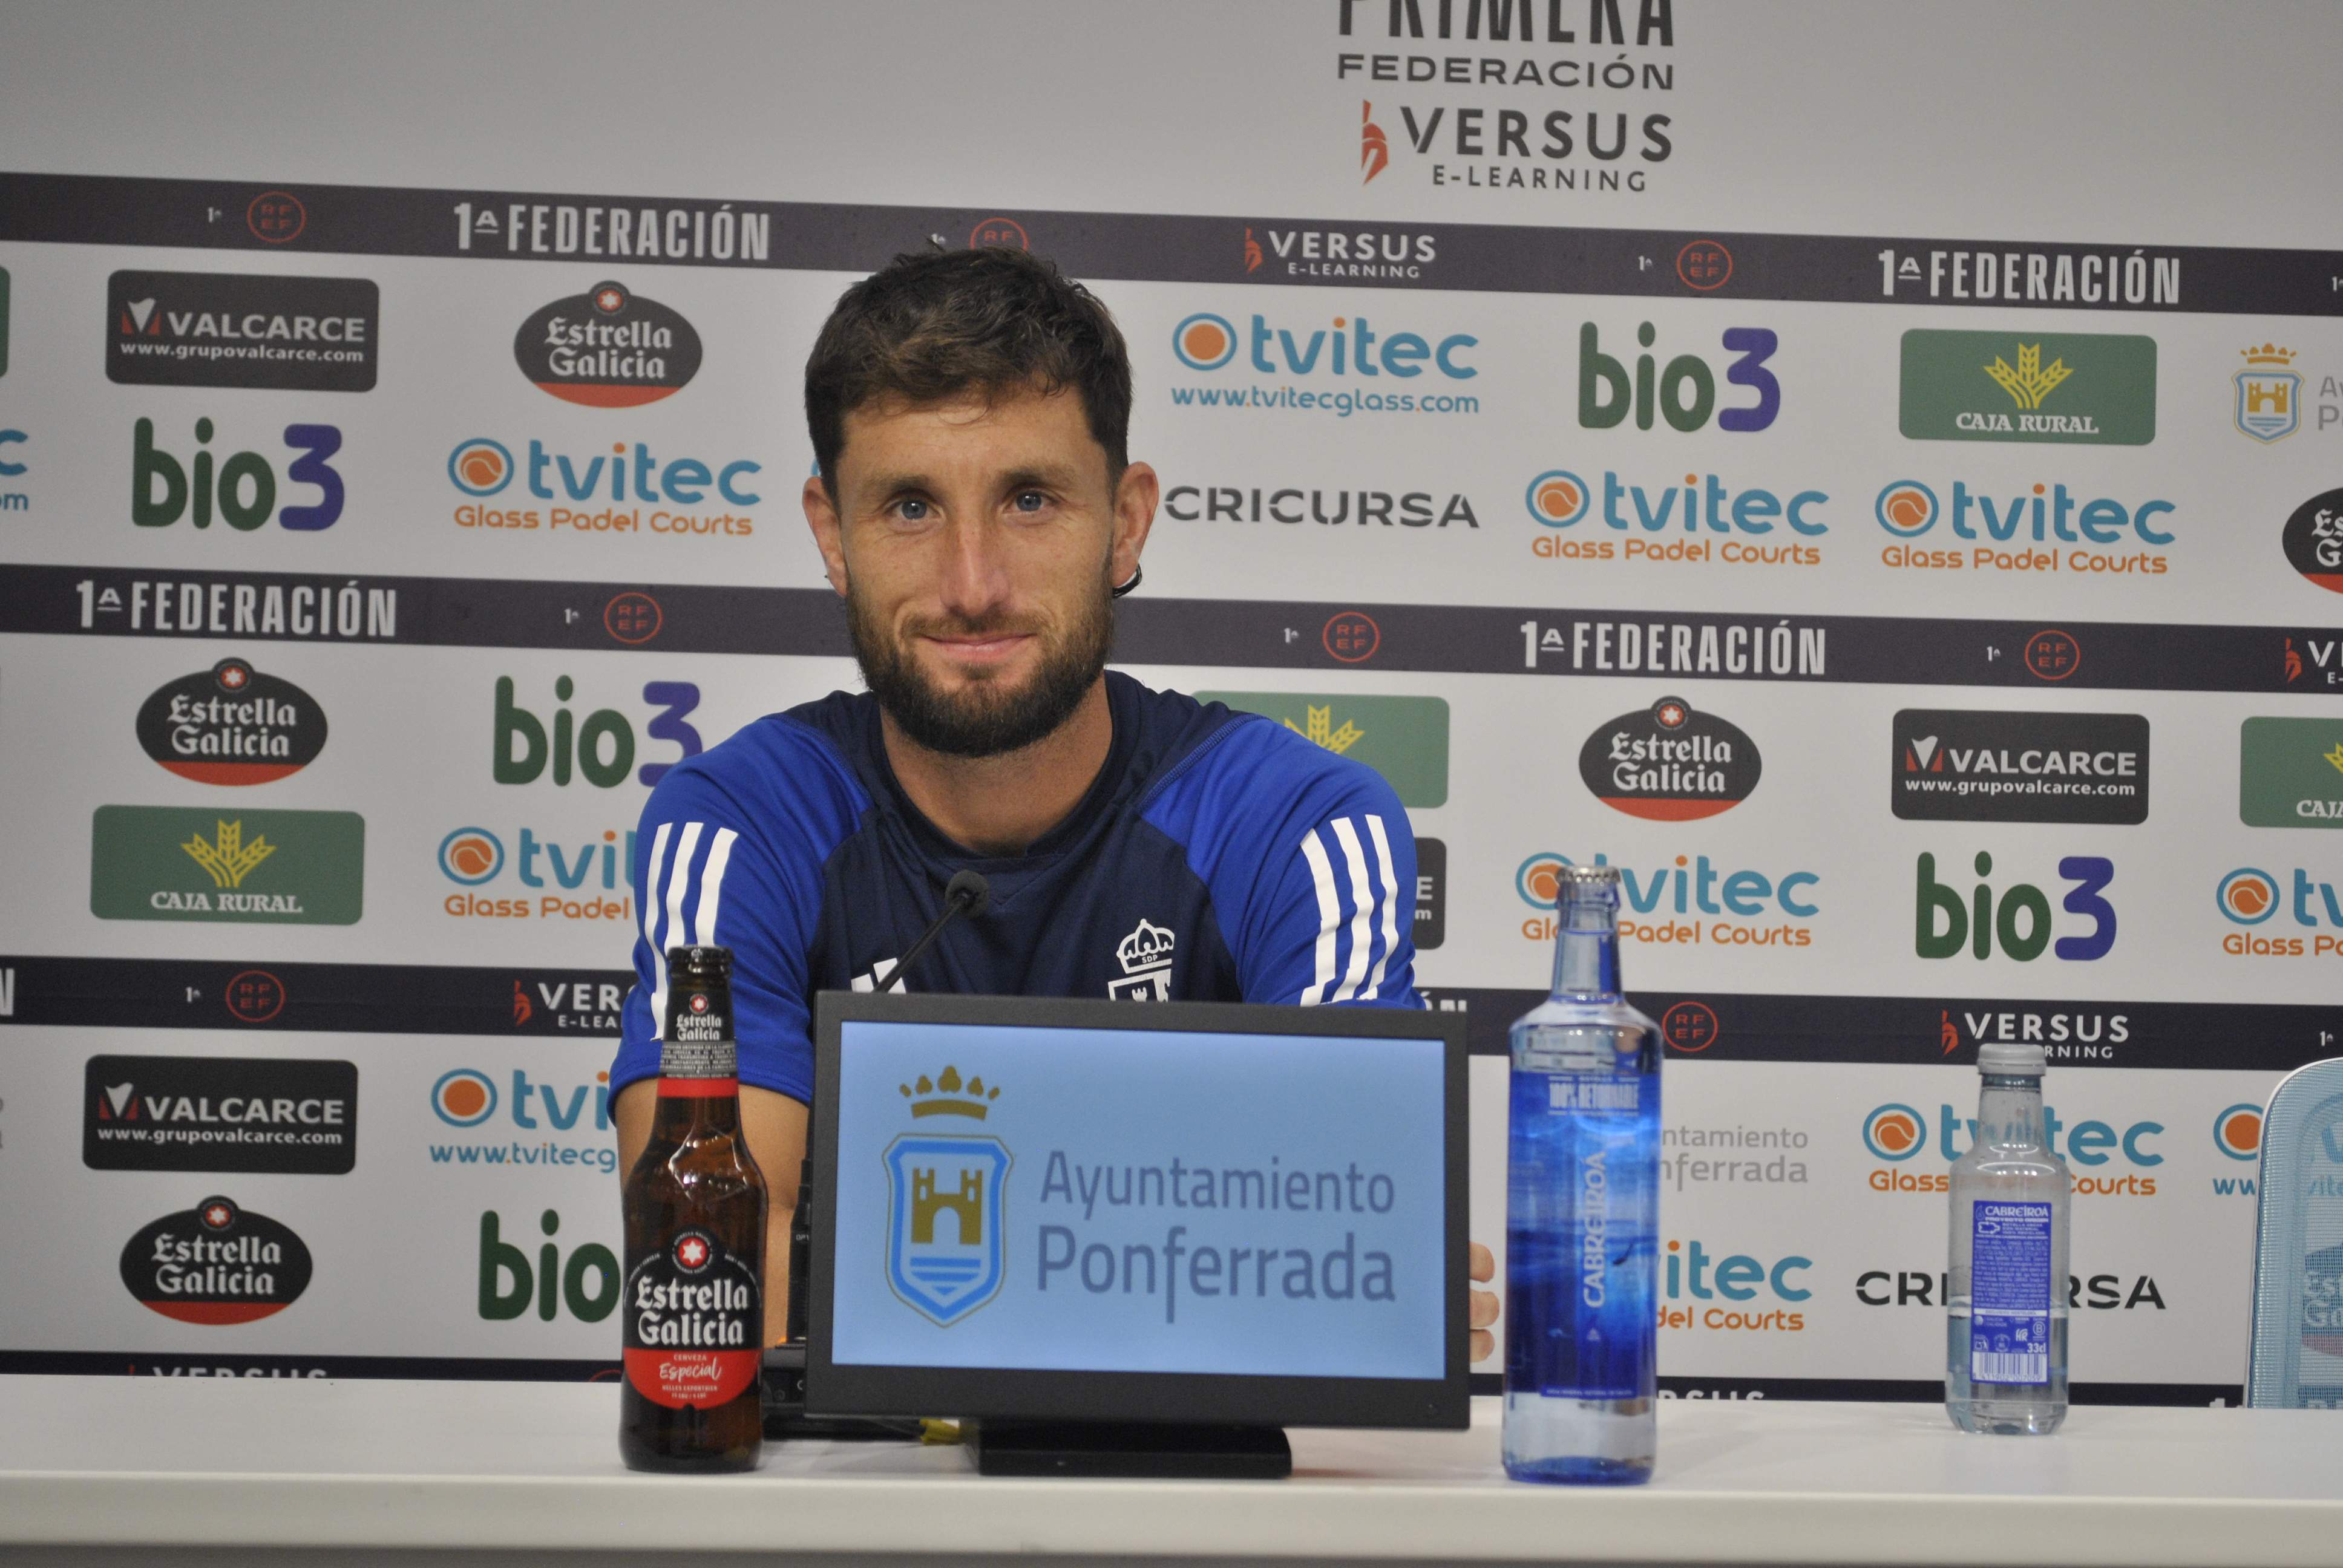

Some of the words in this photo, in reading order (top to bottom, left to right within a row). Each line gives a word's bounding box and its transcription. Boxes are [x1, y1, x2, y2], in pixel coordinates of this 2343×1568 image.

[1338, 53, 1673, 90] FEDERACIÓN
[1400, 106, 1671, 162] VERSUS
[1433, 165, 1645, 192] E-LEARNING
[509, 204, 768, 260] FEDERACIÓN
[1268, 230, 1436, 263] VERSUS
[1288, 263, 1420, 278] E-LEARNING
[1931, 250, 2179, 304] FEDERACIÓN
[168, 313, 365, 341] VALCARCE
[545, 317, 671, 348] Estrella
[120, 342, 363, 362] www.grupovalcarce.com
[1251, 314, 1479, 379] tvitec
[549, 348, 665, 378] Galicia
[1578, 321, 1780, 432] bio3
[1171, 385, 1479, 416] www.tvitecglass.com
[1956, 413, 2013, 431] CAJA
[2019, 415, 2099, 434] RURAL
[133, 417, 344, 531] bio3
[529, 440, 762, 506] tvitec
[1164, 486, 1480, 528] CRICURSA
[1604, 471, 1829, 535] tvitec
[1953, 482, 2176, 545] tvitec
[454, 505, 539, 528] Glass
[551, 509, 638, 532] Padel
[650, 512, 752, 535] Courts
[1532, 535, 1614, 558] Glass
[1625, 538, 1710, 562] Padel
[1721, 542, 1820, 564] Courts
[1882, 544, 1962, 568] Glass
[1974, 548, 2058, 571] Padel
[2069, 552, 2168, 574] Courts
[131, 581, 396, 636] FEDERACIÓN
[1574, 620, 1825, 675] FEDERACIÓN
[166, 694, 296, 727] Estrella
[171, 726, 290, 756] Galicia
[493, 675, 703, 788] bio3
[1608, 732, 1731, 764] Estrella
[1949, 750, 2137, 776] VALCARCE
[1613, 762, 1726, 793] Galicia
[1905, 778, 2135, 797] www.grupovalcarce.com
[151, 892, 211, 910] CAJA
[218, 893, 302, 912] RURAL
[444, 893, 529, 916] Glass
[541, 896, 629, 920] Padel
[1915, 851, 2117, 961] bio3
[1618, 920, 1700, 944] Padel
[1711, 924, 1811, 946] Courts
[2223, 932, 2304, 956] Glass
[1142, 955, 1158, 963] SDP
[538, 983, 635, 1011] VER
[677, 1014, 722, 1027] Estrella
[677, 1027, 720, 1041] Galicia
[1964, 1013, 2129, 1042] VERSUS
[145, 1097, 344, 1124] VALCARCE
[98, 1127, 342, 1145] www.grupovalcarce.com
[1662, 1126, 1808, 1148] ntamiento
[430, 1143, 616, 1173] www.tvitecg
[1041, 1149, 1394, 1220] Ayuntamiento
[1869, 1168, 1949, 1192] Glass
[2069, 1175, 2156, 1195] ourts
[151, 1233, 281, 1265] Estrella
[156, 1264, 275, 1295] Galicia
[479, 1209, 620, 1323] bio
[1038, 1225, 1395, 1323] Ponferrada
[635, 1275, 748, 1311] Estrella
[638, 1310, 743, 1345] Galicia
[1704, 1308, 1804, 1330] Courts
[2028, 1343, 2046, 1353] 33cl
[659, 1357, 721, 1382] Especial
